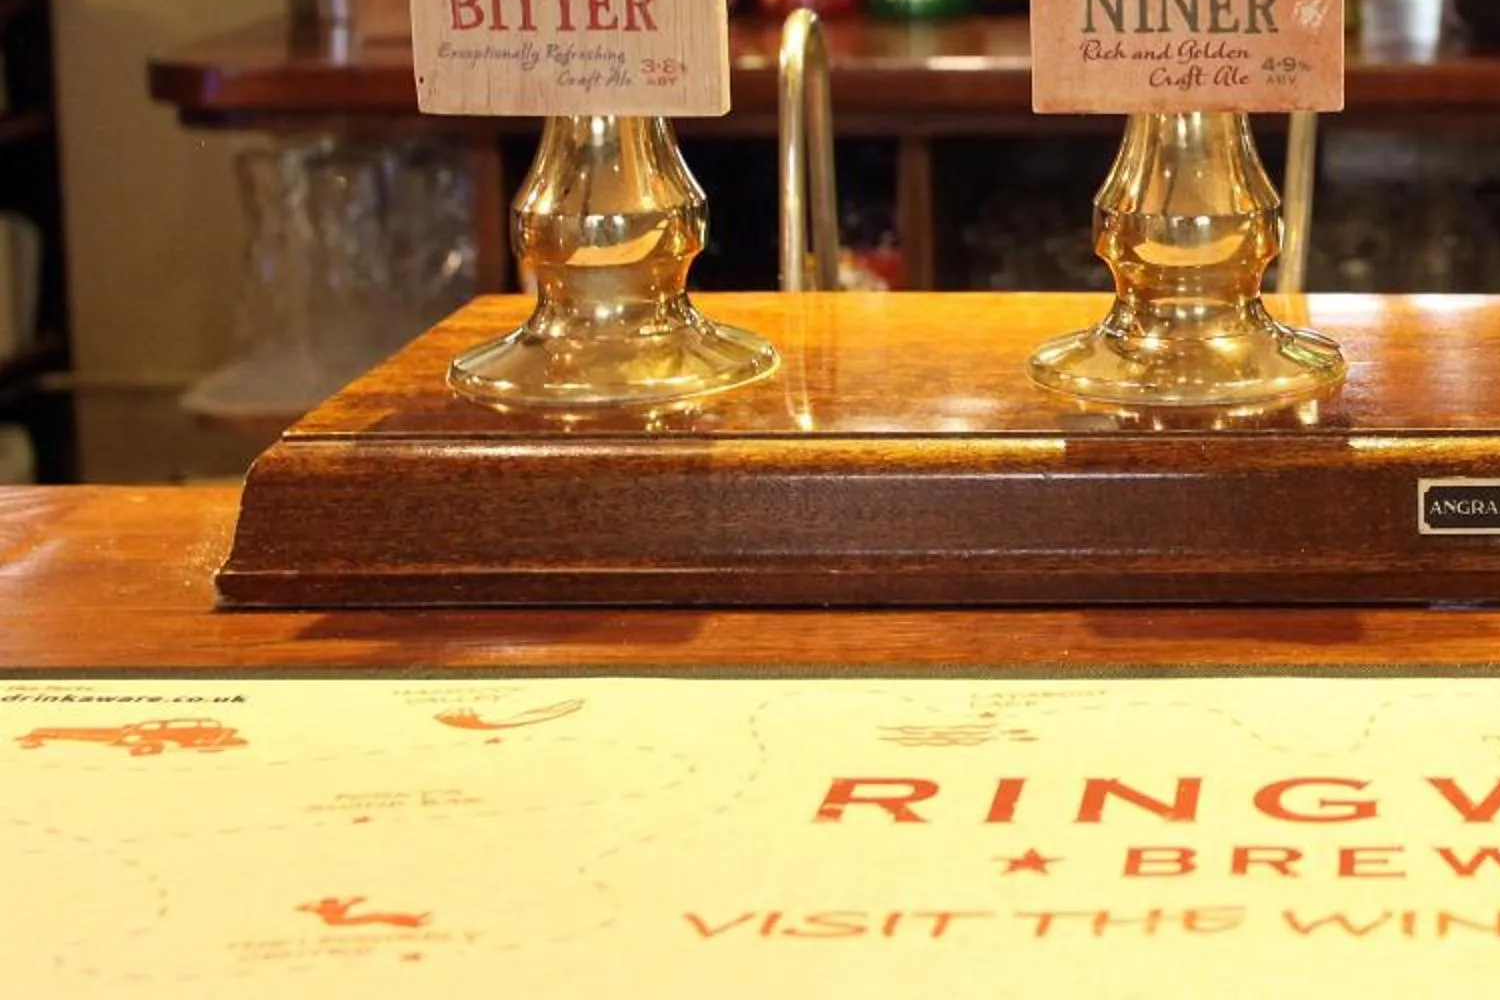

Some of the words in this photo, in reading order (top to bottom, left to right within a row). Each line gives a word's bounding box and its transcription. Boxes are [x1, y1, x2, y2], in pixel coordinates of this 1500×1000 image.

[546, 43, 625, 65] Refreshing
[1080, 39, 1130, 64] Rich
[1131, 43, 1172, 60] and
[1177, 40, 1249, 64] Golden
[557, 71, 600, 93] Craft
[1150, 67, 1207, 90] Craft
[1213, 65, 1249, 87] Ale
[682, 910, 993, 939] VISIT
[1013, 906, 1246, 939] THE
